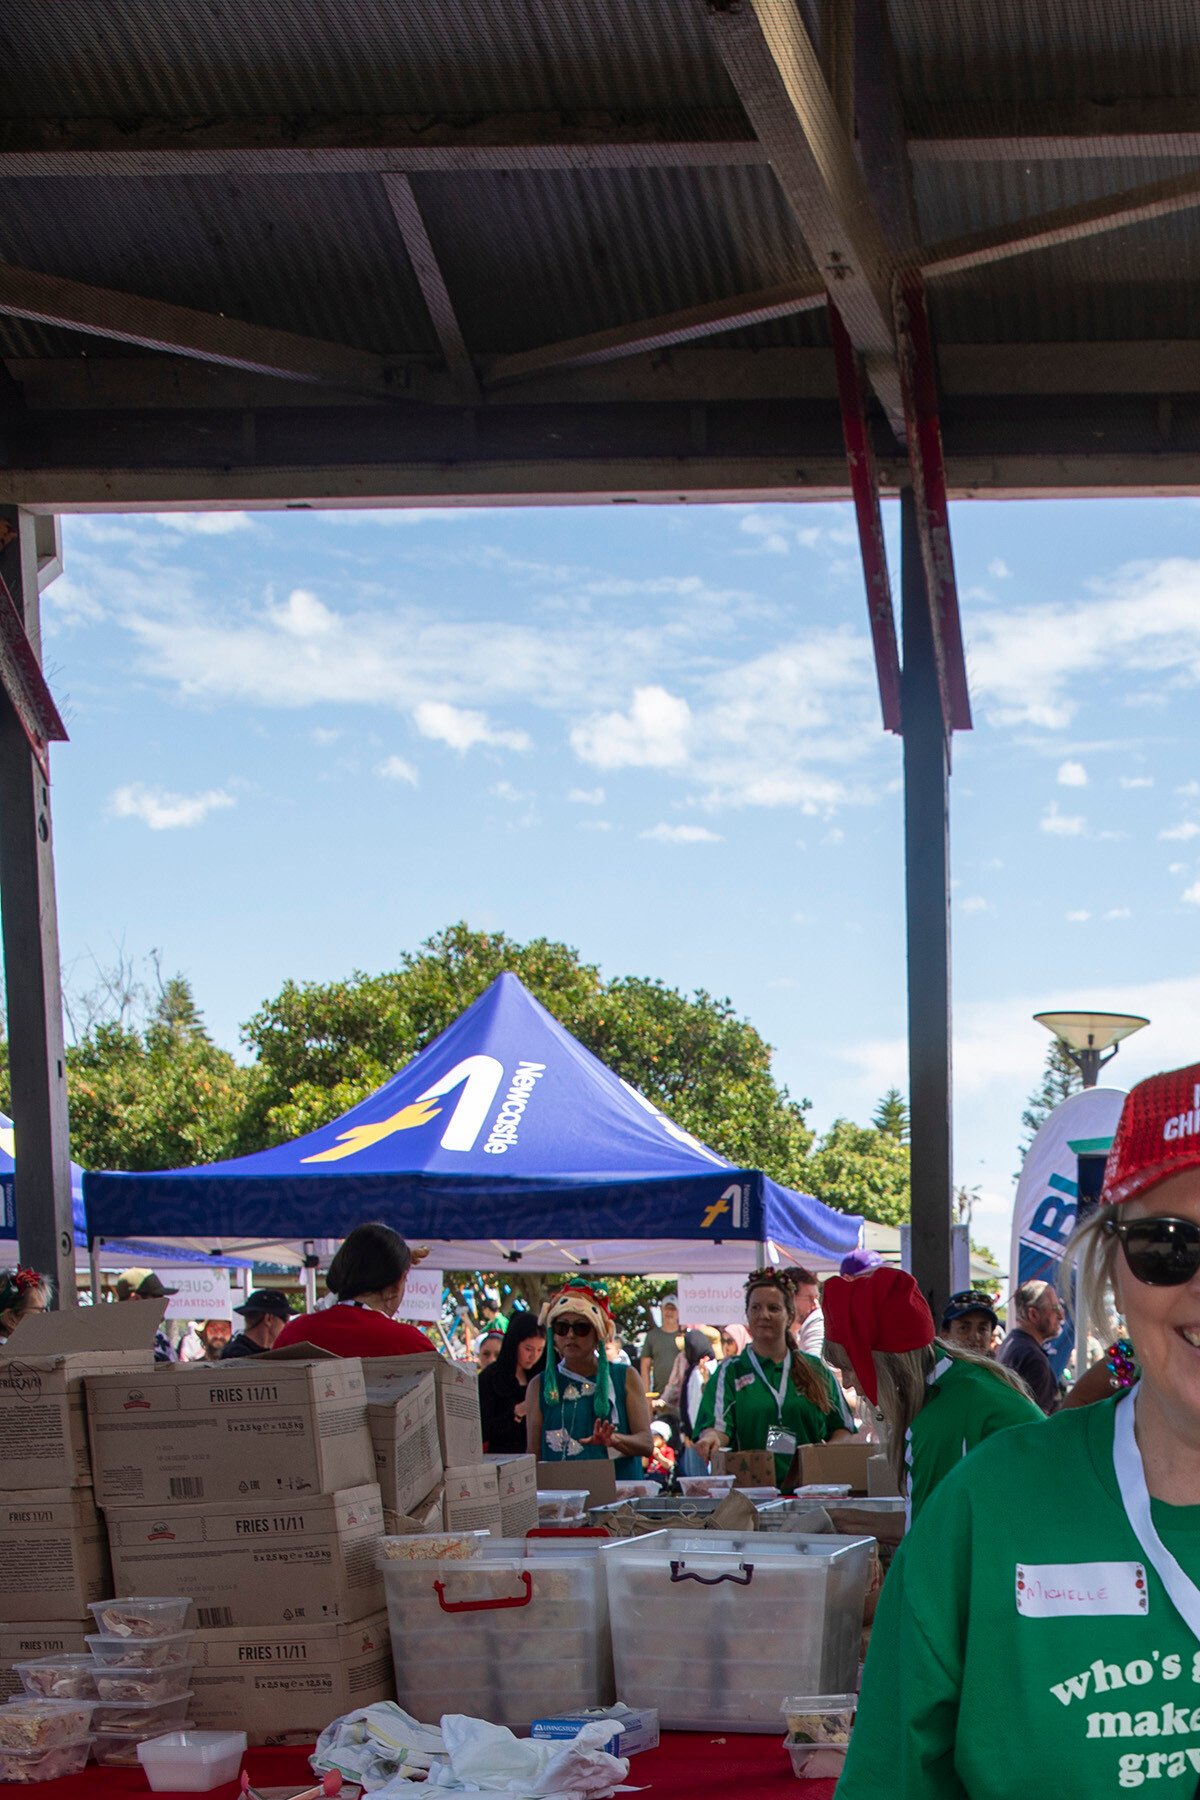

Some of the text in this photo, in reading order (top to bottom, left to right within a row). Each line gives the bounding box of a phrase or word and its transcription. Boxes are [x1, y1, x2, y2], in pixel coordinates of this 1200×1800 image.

[483, 1060, 547, 1154] Newcastle
[209, 1386, 278, 1403] FRIES 11/11
[8, 1511, 53, 1521] FRIES 11/11
[235, 1516, 304, 1533] FRIES 11/11
[20, 1641, 42, 1650] FRIES
[238, 1645, 307, 1660] FRIES 11/11
[1049, 1650, 1183, 1706] who's
[542, 1724, 580, 1732] LIVINGSTON
